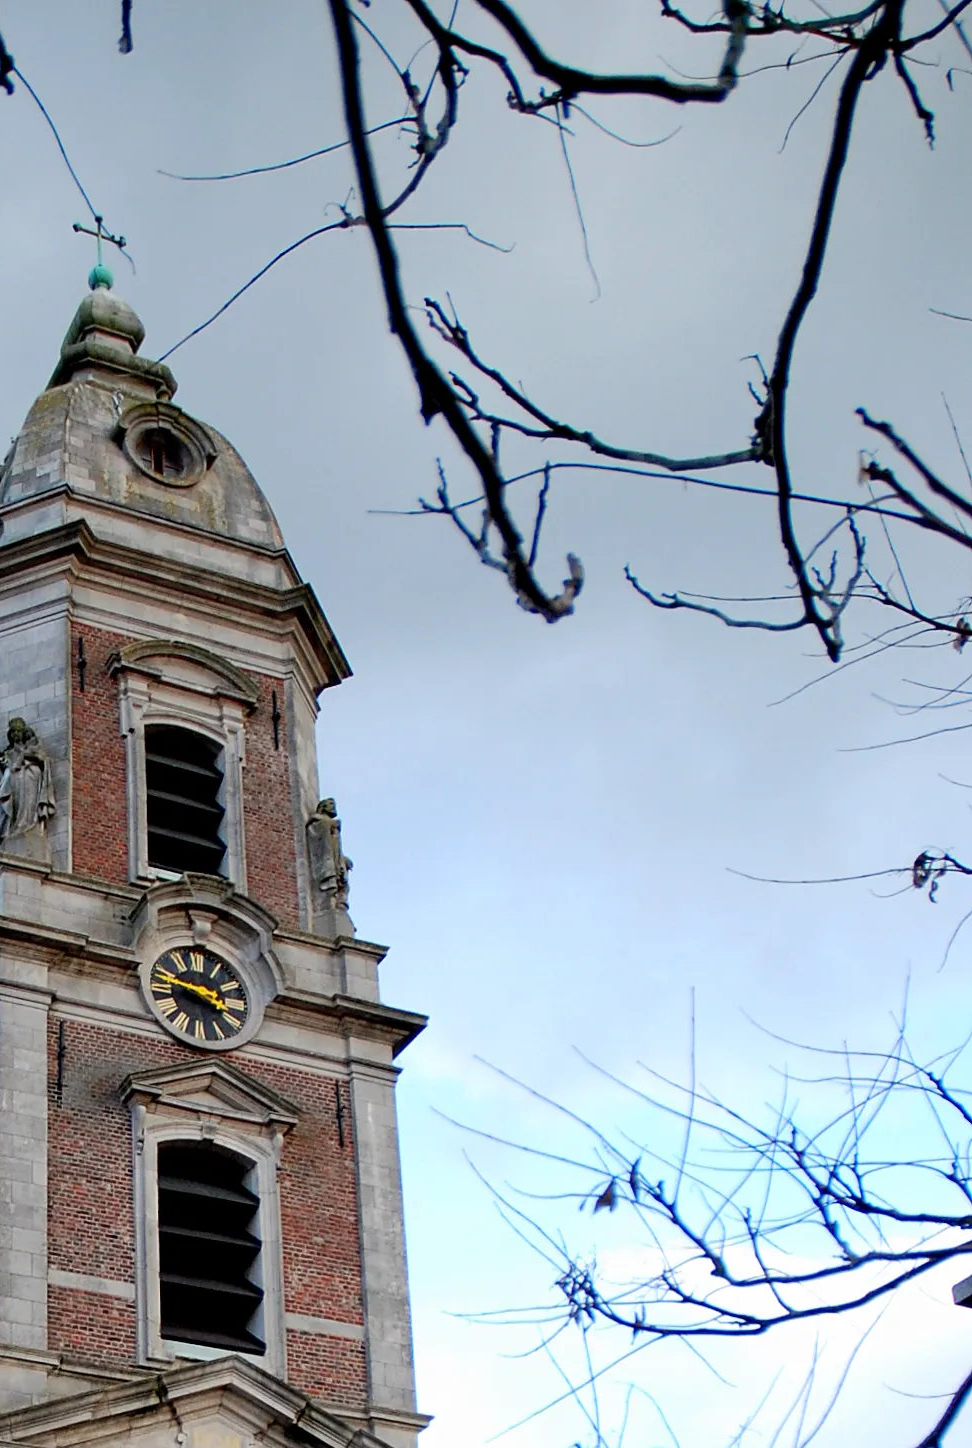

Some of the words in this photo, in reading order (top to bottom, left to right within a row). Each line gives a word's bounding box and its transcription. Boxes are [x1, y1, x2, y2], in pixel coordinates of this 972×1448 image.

[190, 952, 204, 973] XII
[210, 963, 222, 979] I
[220, 981, 239, 992] II
[225, 998, 244, 1011] III
[212, 1020, 225, 1040] V
